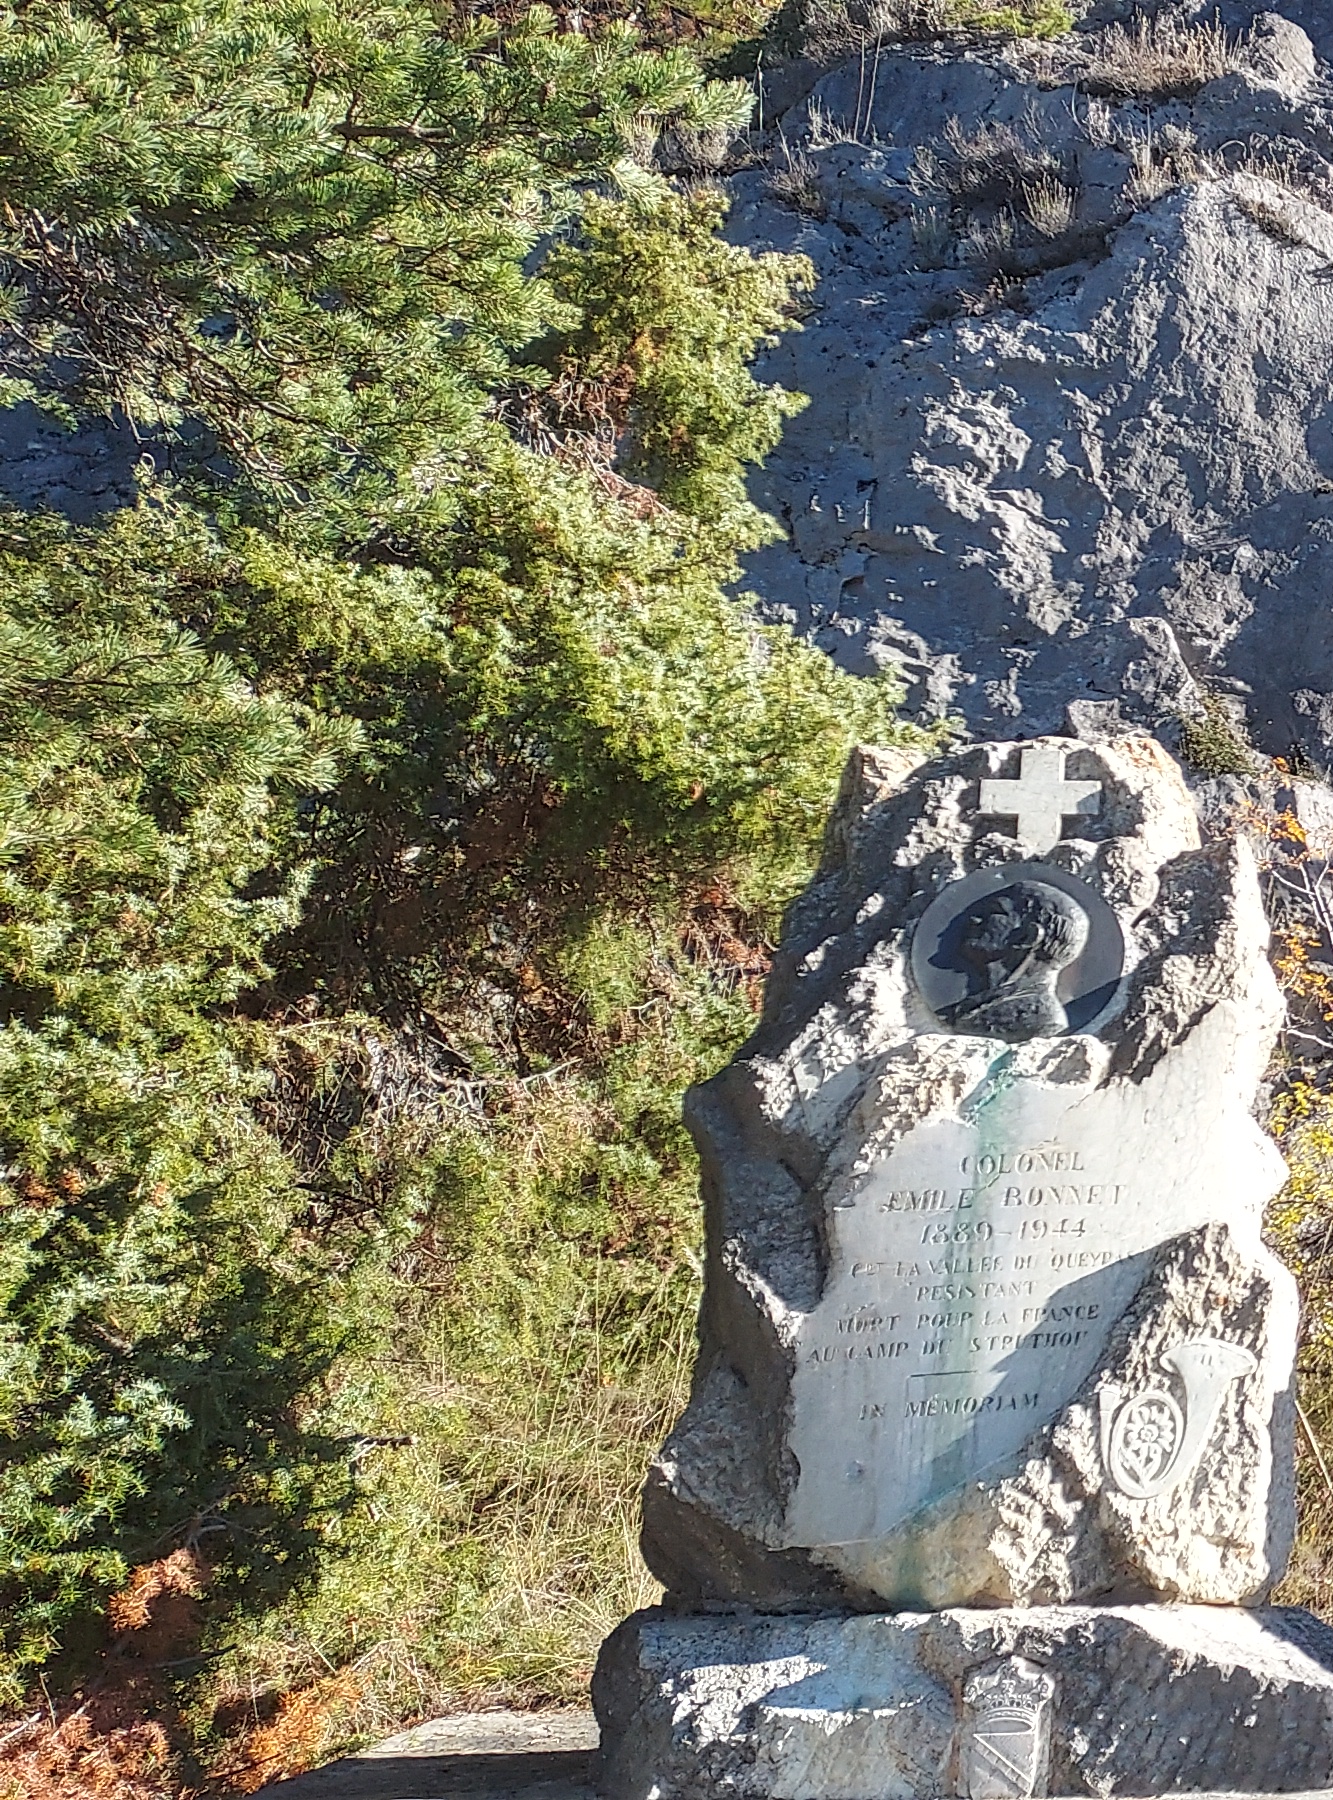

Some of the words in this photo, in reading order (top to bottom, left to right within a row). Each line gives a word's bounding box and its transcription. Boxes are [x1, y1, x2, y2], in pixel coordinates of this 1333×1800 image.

[959, 1152, 1085, 1175] COLONEL
[1000, 1184, 1127, 1207] BONNET
[894, 1261, 920, 1278] LA
[1012, 1256, 1037, 1271] DU
[1051, 1250, 1135, 1272] QUEYR
[835, 1313, 900, 1335] MORT
[981, 1308, 1008, 1326] LA
[1021, 1303, 1100, 1325] FRANCE
[806, 1346, 837, 1364] AU
[847, 1341, 909, 1361] CAMP
[921, 1338, 953, 1356] DU
[858, 1402, 886, 1421] IN
